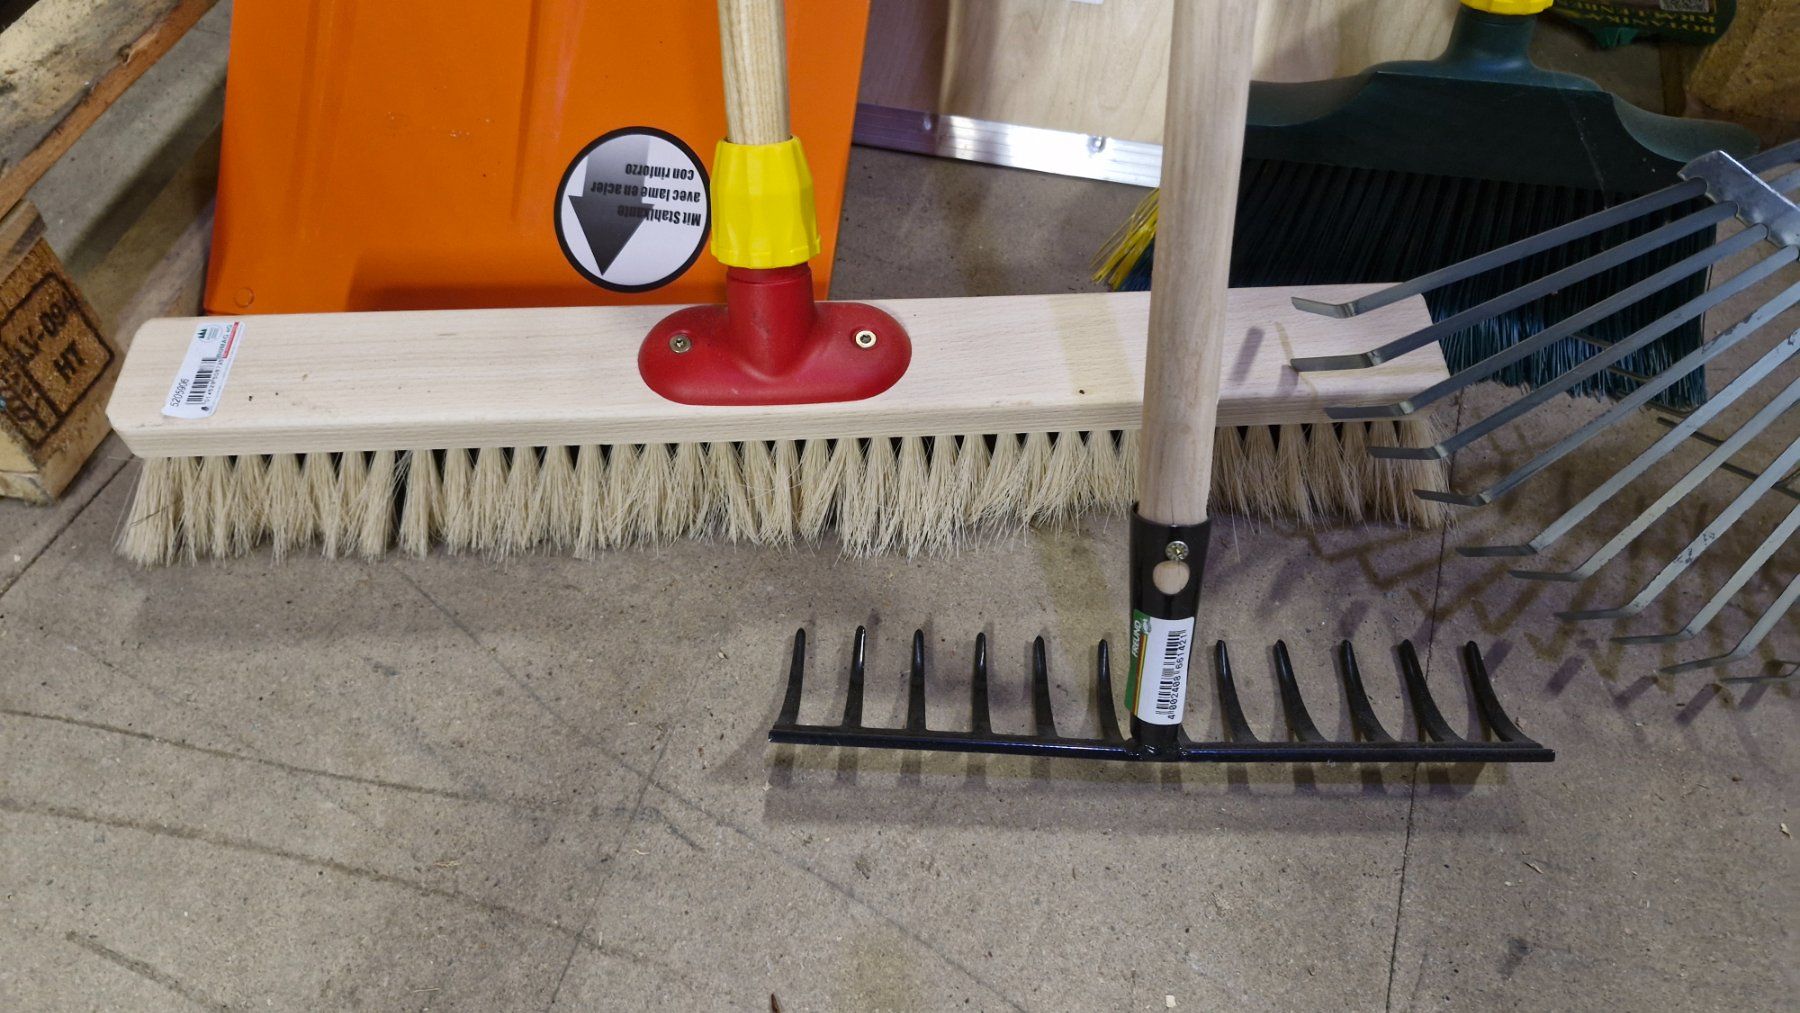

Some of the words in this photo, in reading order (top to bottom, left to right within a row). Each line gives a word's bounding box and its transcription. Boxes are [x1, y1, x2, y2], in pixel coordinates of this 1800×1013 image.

[625, 163, 670, 180] rinforzo
[672, 168, 695, 181] con
[590, 181, 621, 195] acier
[623, 184, 639, 197] en
[640, 186, 671, 202] lame
[672, 189, 701, 203] avec
[617, 204, 681, 225] Stahlkante
[682, 211, 702, 227] Mit
[53, 338, 85, 385] HT
[1131, 620, 1142, 658] FREUND
